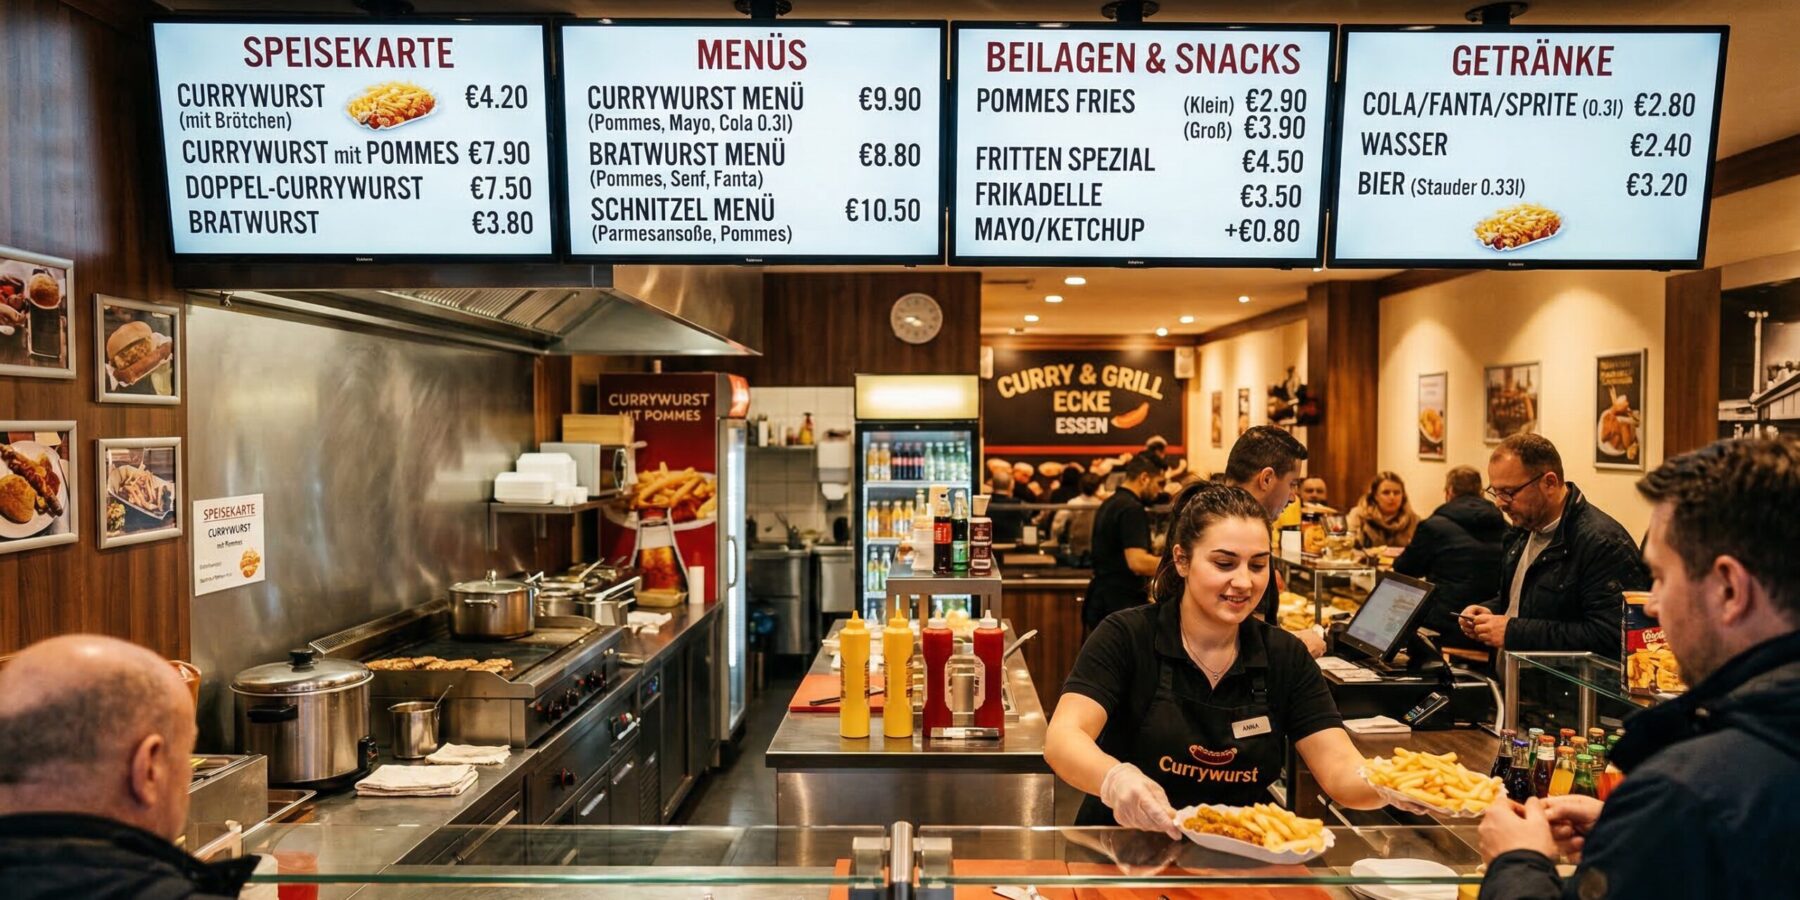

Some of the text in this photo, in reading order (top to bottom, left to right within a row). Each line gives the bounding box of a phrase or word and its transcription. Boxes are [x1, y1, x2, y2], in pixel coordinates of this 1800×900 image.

[244, 36, 454, 68] SPEISEKARTE
[698, 33, 806, 70] MENÜS
[988, 42, 1300, 74] BEILAGEN & SNACKS
[1453, 39, 1614, 76] GETRÄNKE
[178, 83, 527, 109] CURRYWURST €4.20
[588, 82, 920, 111] CURRYWURST MENÜ €9.90
[978, 88, 1306, 116] POMMES FRIES (Klein) €2.90
[1364, 92, 1578, 118] COLA/FANTA/SPRITE
[1634, 93, 1695, 117] €2.80
[180, 111, 291, 131] (mit Brötchen)
[589, 114, 664, 133] (Pommes,
[670, 114, 714, 135] Mayo,
[720, 114, 752, 131] Cola
[1184, 115, 1305, 141] (Groß) €3.90
[183, 140, 529, 164] CURRYWURST mit POMMES €7.90
[590, 138, 920, 166] BRATWURST MENÜ €8.80
[1361, 132, 1691, 157] WASSER €2.40
[977, 147, 1303, 173] FRITTEN SPEZIAL €4.50
[186, 175, 531, 199] DOPPEL-CURRYWURST €7.50
[591, 170, 763, 189] (Pommes, Senf, Fanta)
[1359, 172, 1404, 195] BIER
[1411, 178, 1477, 197] (Stauder
[1627, 173, 1687, 196] €3.20
[591, 193, 920, 221] SCHNITZEL MENÜ €10.50
[976, 182, 1301, 208] FRIKADELLE €3.50
[189, 210, 533, 234] BRATWURST €3.80
[593, 225, 792, 244] (Parmesansoße, Pommes)
[976, 218, 1299, 243] MAYO/KETCHUP +€0.80
[997, 363, 1163, 400] CURRY & GRILL
[609, 393, 710, 406] CURRYWURST
[1054, 391, 1111, 412] ECKE
[645, 410, 701, 421] POMMES
[1056, 417, 1108, 434] ESSEN
[204, 504, 256, 520] SPEISEKARTE
[208, 523, 251, 538] CURRYWURST
[1242, 723, 1259, 731] ANNA
[1159, 756, 1258, 783] Currywurst
